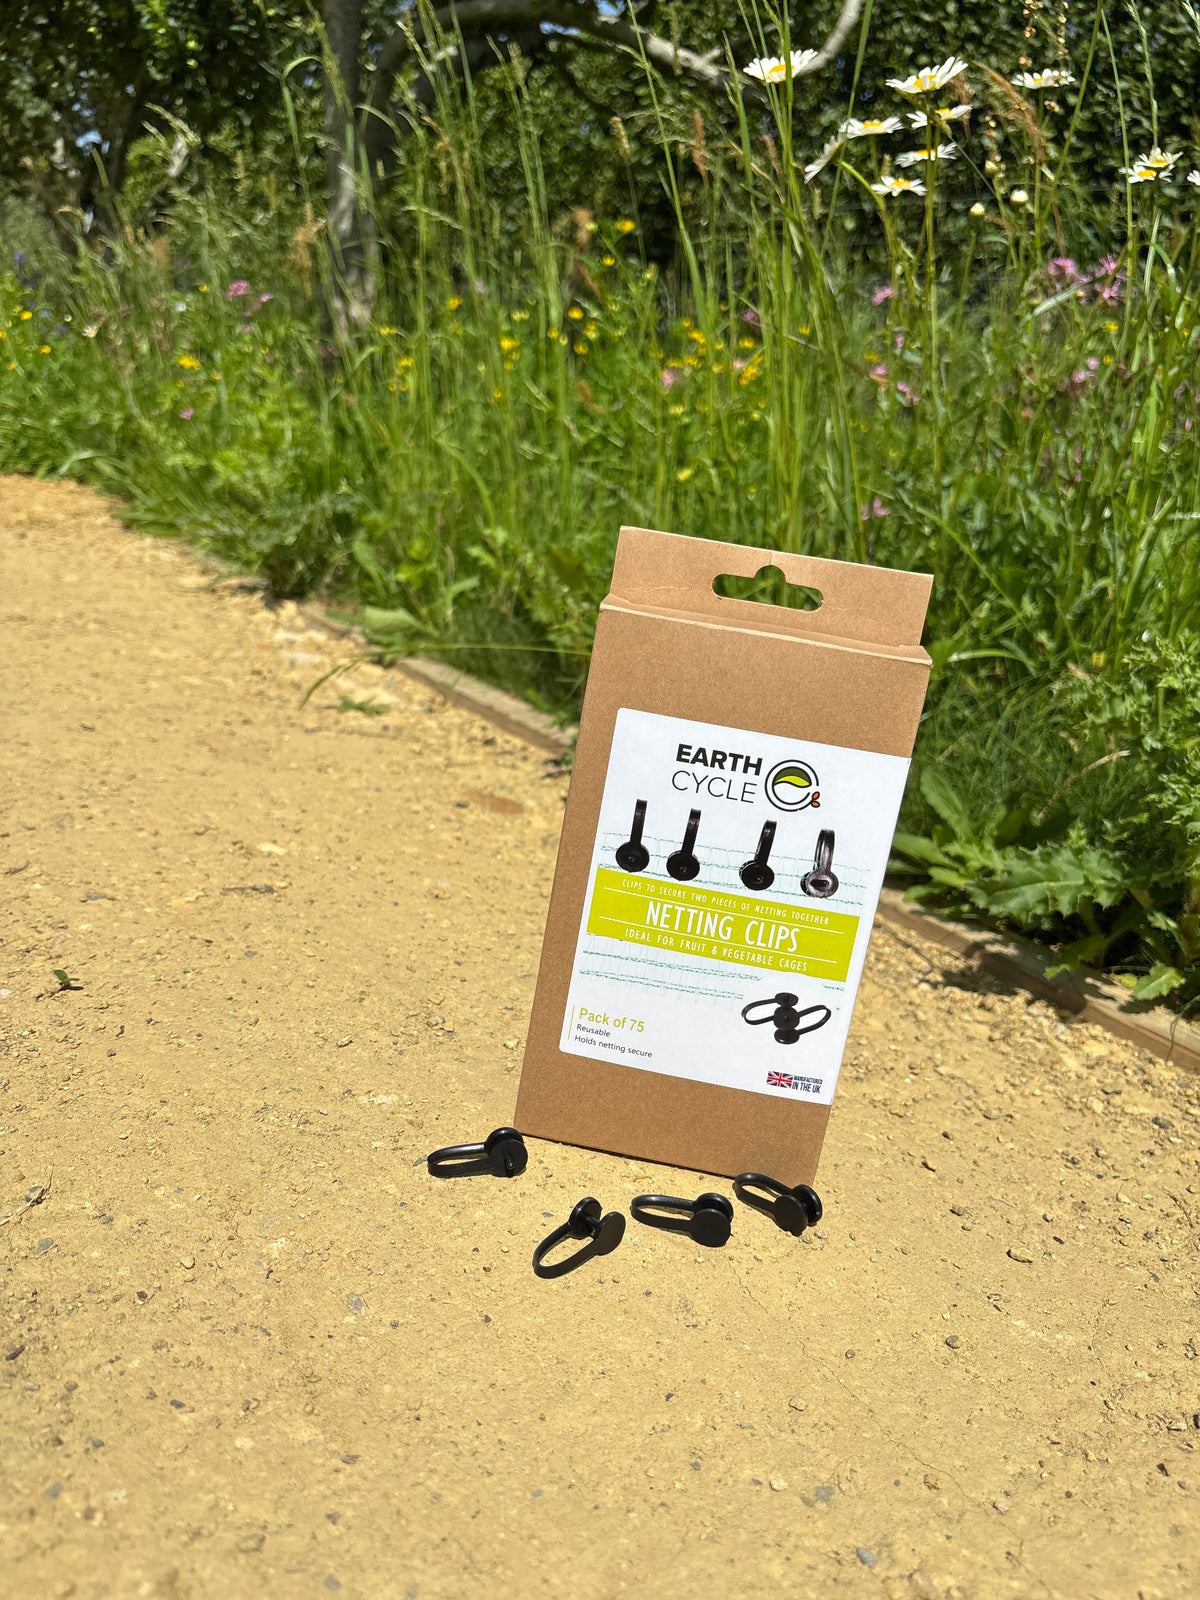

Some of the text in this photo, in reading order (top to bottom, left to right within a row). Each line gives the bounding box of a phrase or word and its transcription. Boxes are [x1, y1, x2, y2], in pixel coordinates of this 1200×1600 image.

[675, 743, 763, 776] EARTH
[671, 770, 758, 804] CYCLE
[622, 879, 830, 926] CLIPS TO SECURE TWO PIECES OF NETTING TOGETHER
[645, 900, 800, 953] NETTING CLIPS
[624, 928, 808, 972] IDEAL FOR FRUIT & VEGETABLE CAGES
[576, 1023, 611, 1038] Reusable
[578, 1007, 645, 1033] Pack of 75
[574, 1034, 653, 1058] Holds netting secure
[791, 1081, 822, 1094] IN THE UK
[793, 1075, 823, 1085] MANUFACTURED
